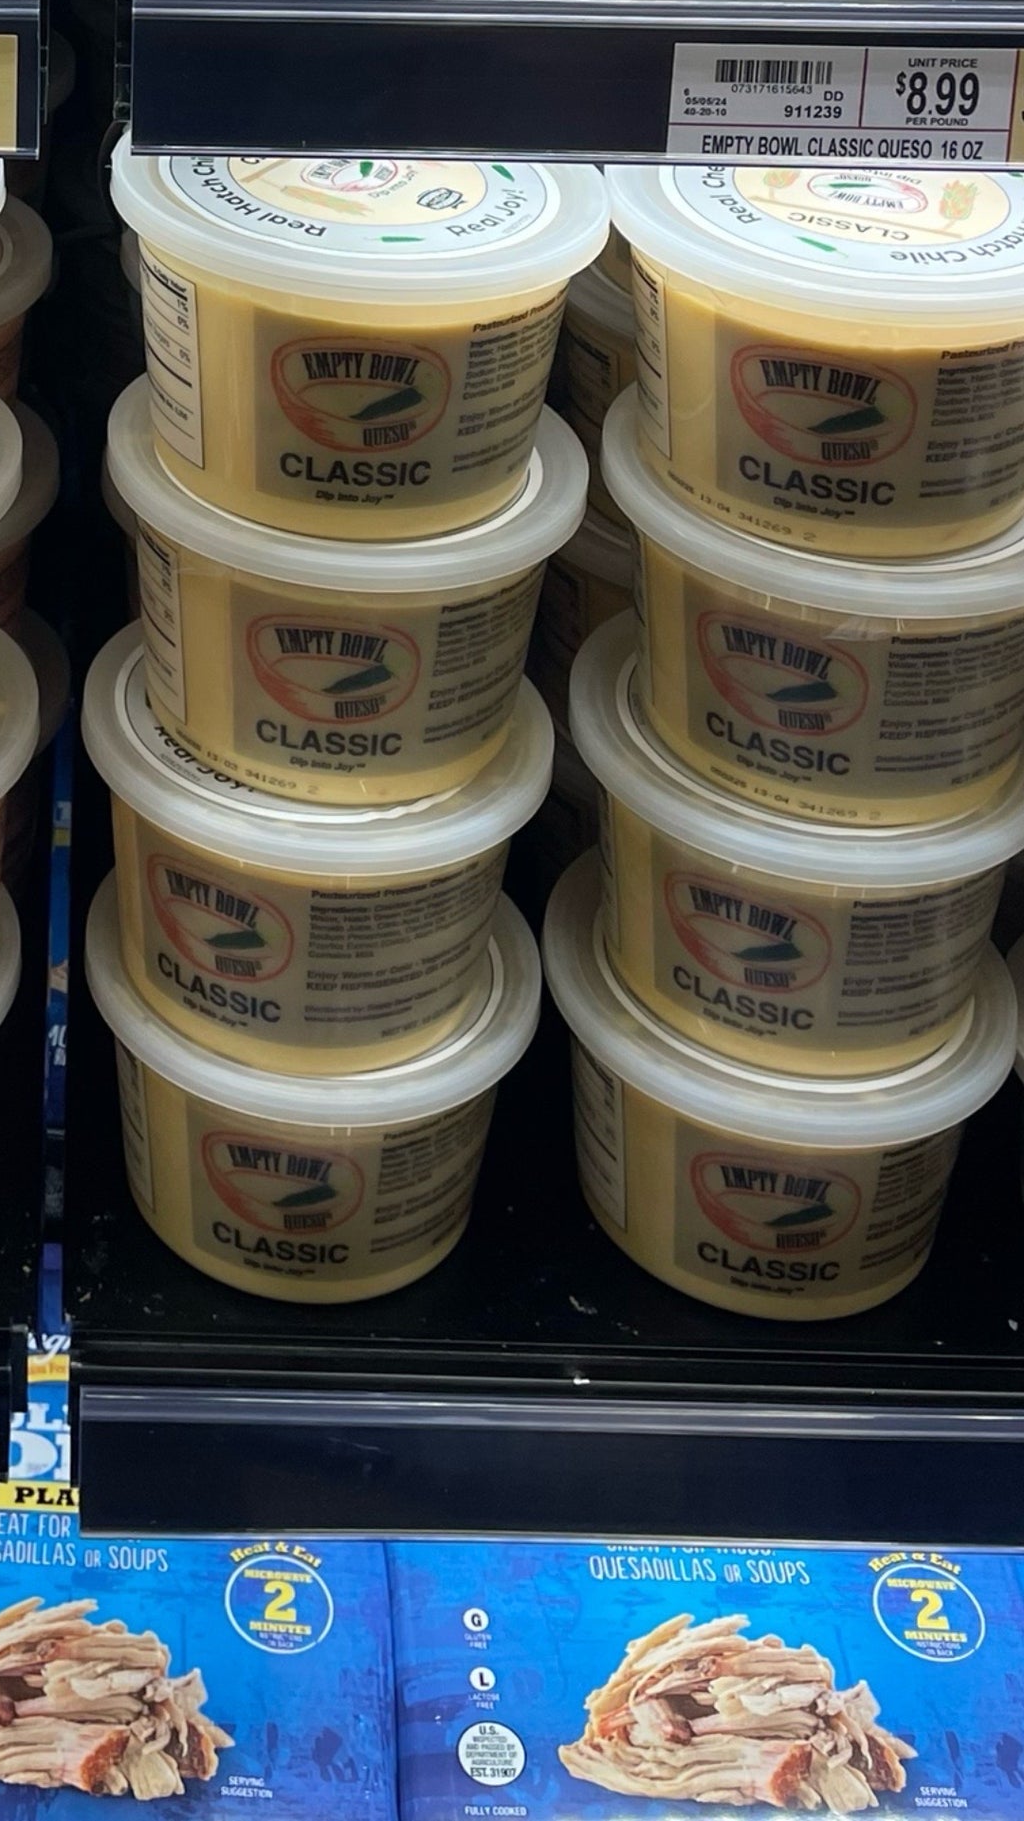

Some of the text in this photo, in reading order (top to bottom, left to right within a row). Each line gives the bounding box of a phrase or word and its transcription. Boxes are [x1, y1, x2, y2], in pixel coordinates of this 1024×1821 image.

[908, 57, 978, 69] UNIT PRICE
[824, 90, 844, 102] DD
[895, 71, 980, 117] $8.99
[784, 104, 842, 120] 911239
[905, 117, 969, 127] PER POUND
[702, 134, 983, 161] EMPTY BOWL CLASSIC QUESO 16 OZ
[257, 209, 328, 239] Real
[445, 214, 500, 238] Real
[787, 211, 911, 241] CLASSIC
[279, 451, 432, 488] CLASSIC
[738, 454, 896, 507] CLASSIC
[255, 718, 403, 758] CLASSIC
[705, 711, 850, 777] CLASSIC
[156, 951, 281, 1024] CLASSIC
[672, 965, 815, 1032] CLASSIC
[212, 1221, 350, 1265] CLASSIC
[696, 1240, 841, 1283] CLASSIC
[38, 1513, 71, 1538] FOR
[84, 1549, 102, 1568] OR
[107, 1545, 169, 1572] SOUPS
[229, 1540, 323, 1568] Heat & Eat
[589, 1555, 811, 1586] QUESADILLAS OR SOUPS
[263, 1580, 297, 1622] 2
[249, 1621, 313, 1635] MINUTES
[914, 1786, 968, 1808] SERVING SUGGESTION
